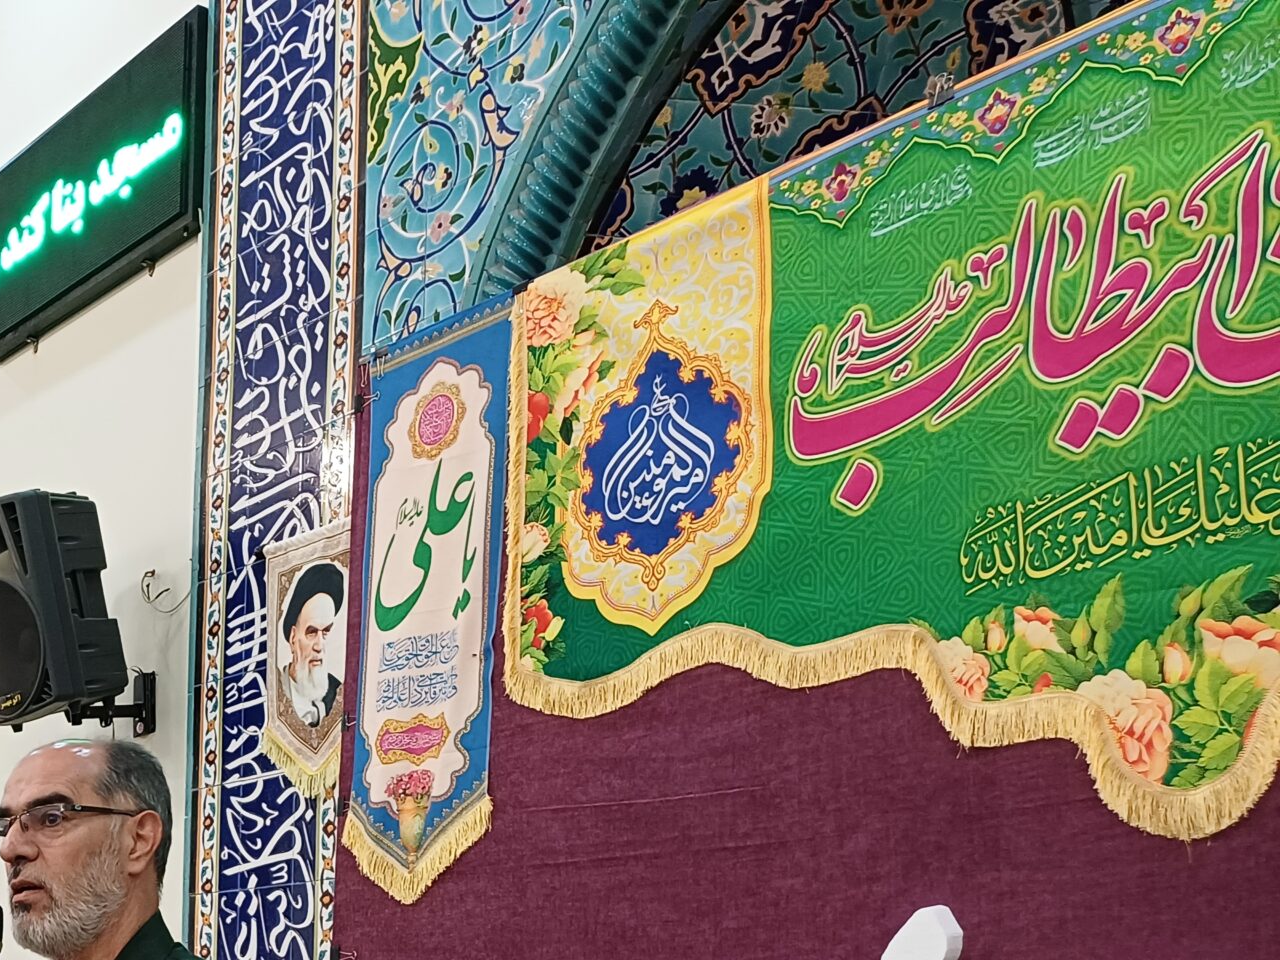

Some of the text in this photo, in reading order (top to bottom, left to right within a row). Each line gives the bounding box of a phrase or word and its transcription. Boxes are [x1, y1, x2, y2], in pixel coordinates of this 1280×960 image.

[88, 111, 183, 206] مسجد
[0, 192, 50, 270] کند
[50, 179, 86, 234] بنا
[374, 457, 475, 631] علی
